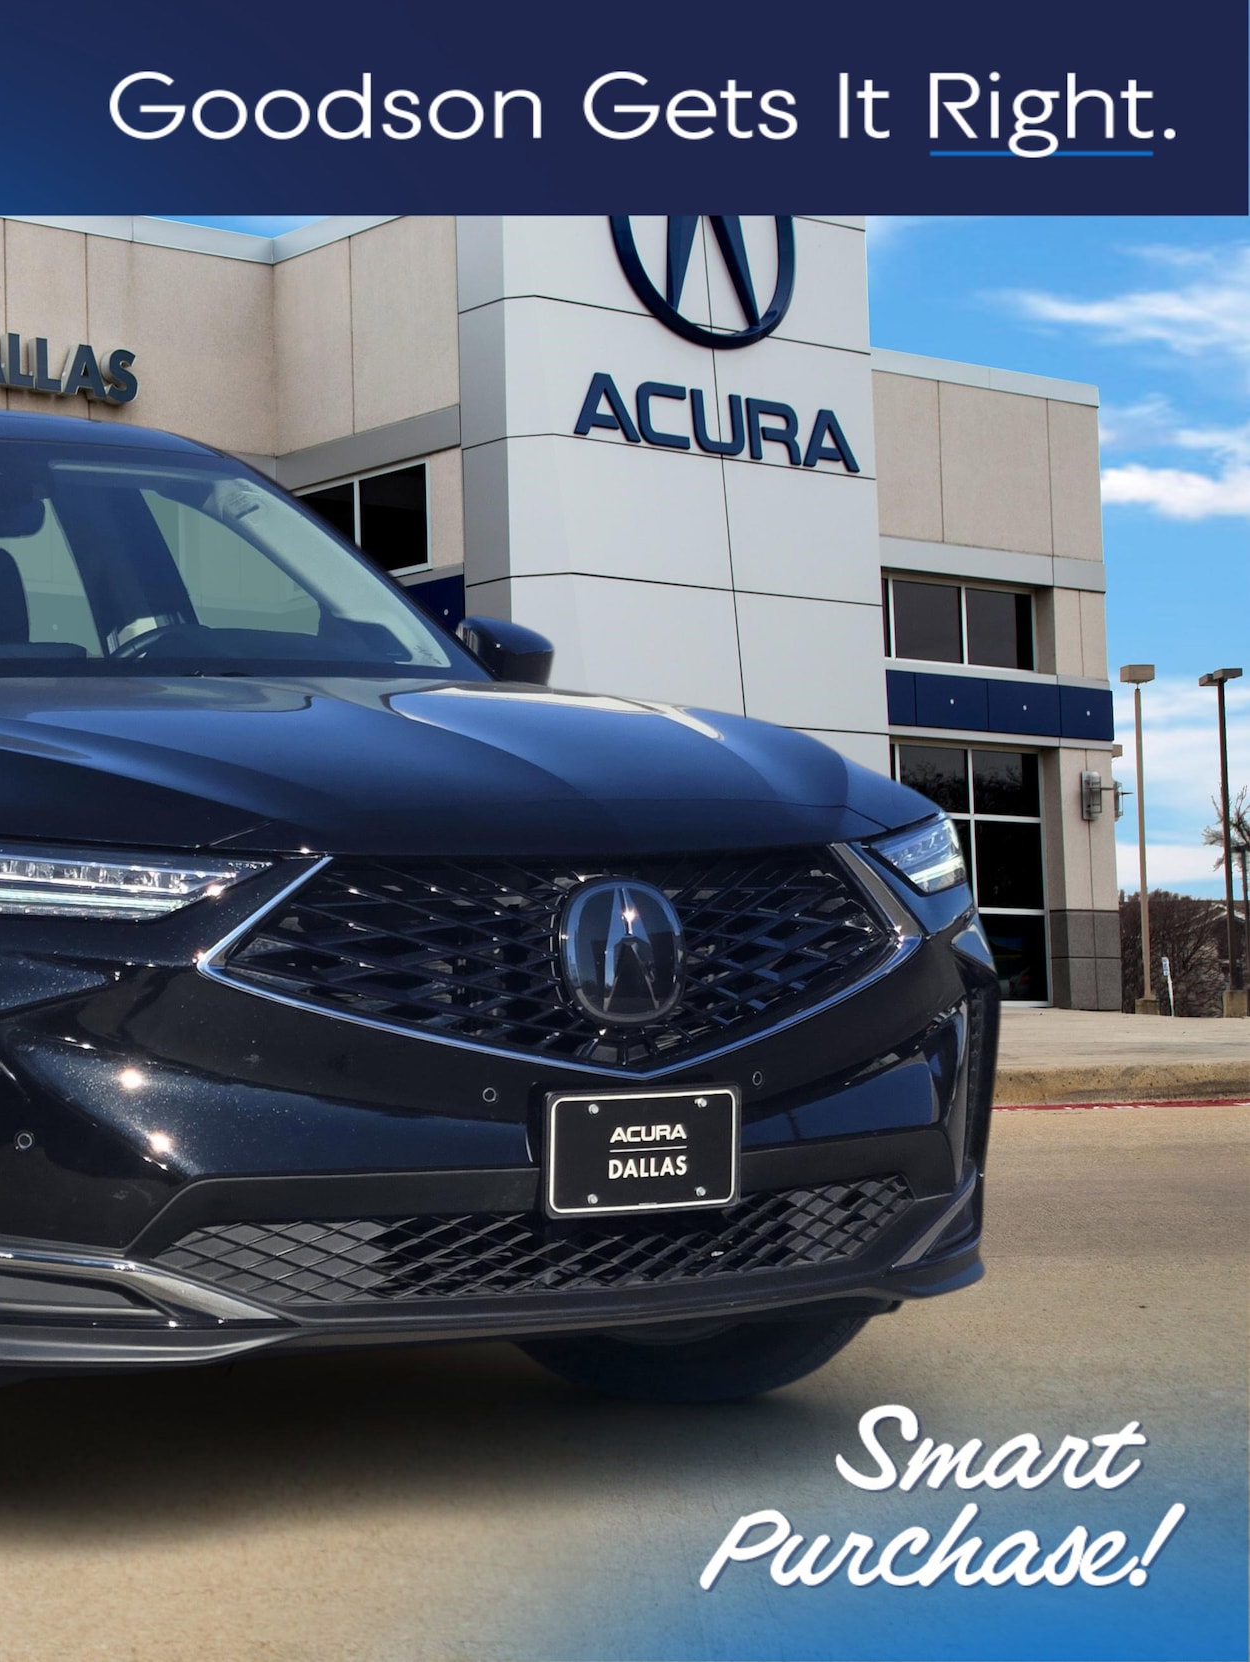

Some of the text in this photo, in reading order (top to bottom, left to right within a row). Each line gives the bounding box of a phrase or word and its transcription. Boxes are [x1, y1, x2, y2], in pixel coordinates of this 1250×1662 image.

[574, 372, 861, 473] ACURA
[609, 1123, 687, 1144] ACURA
[608, 1155, 688, 1180] DALLAS
